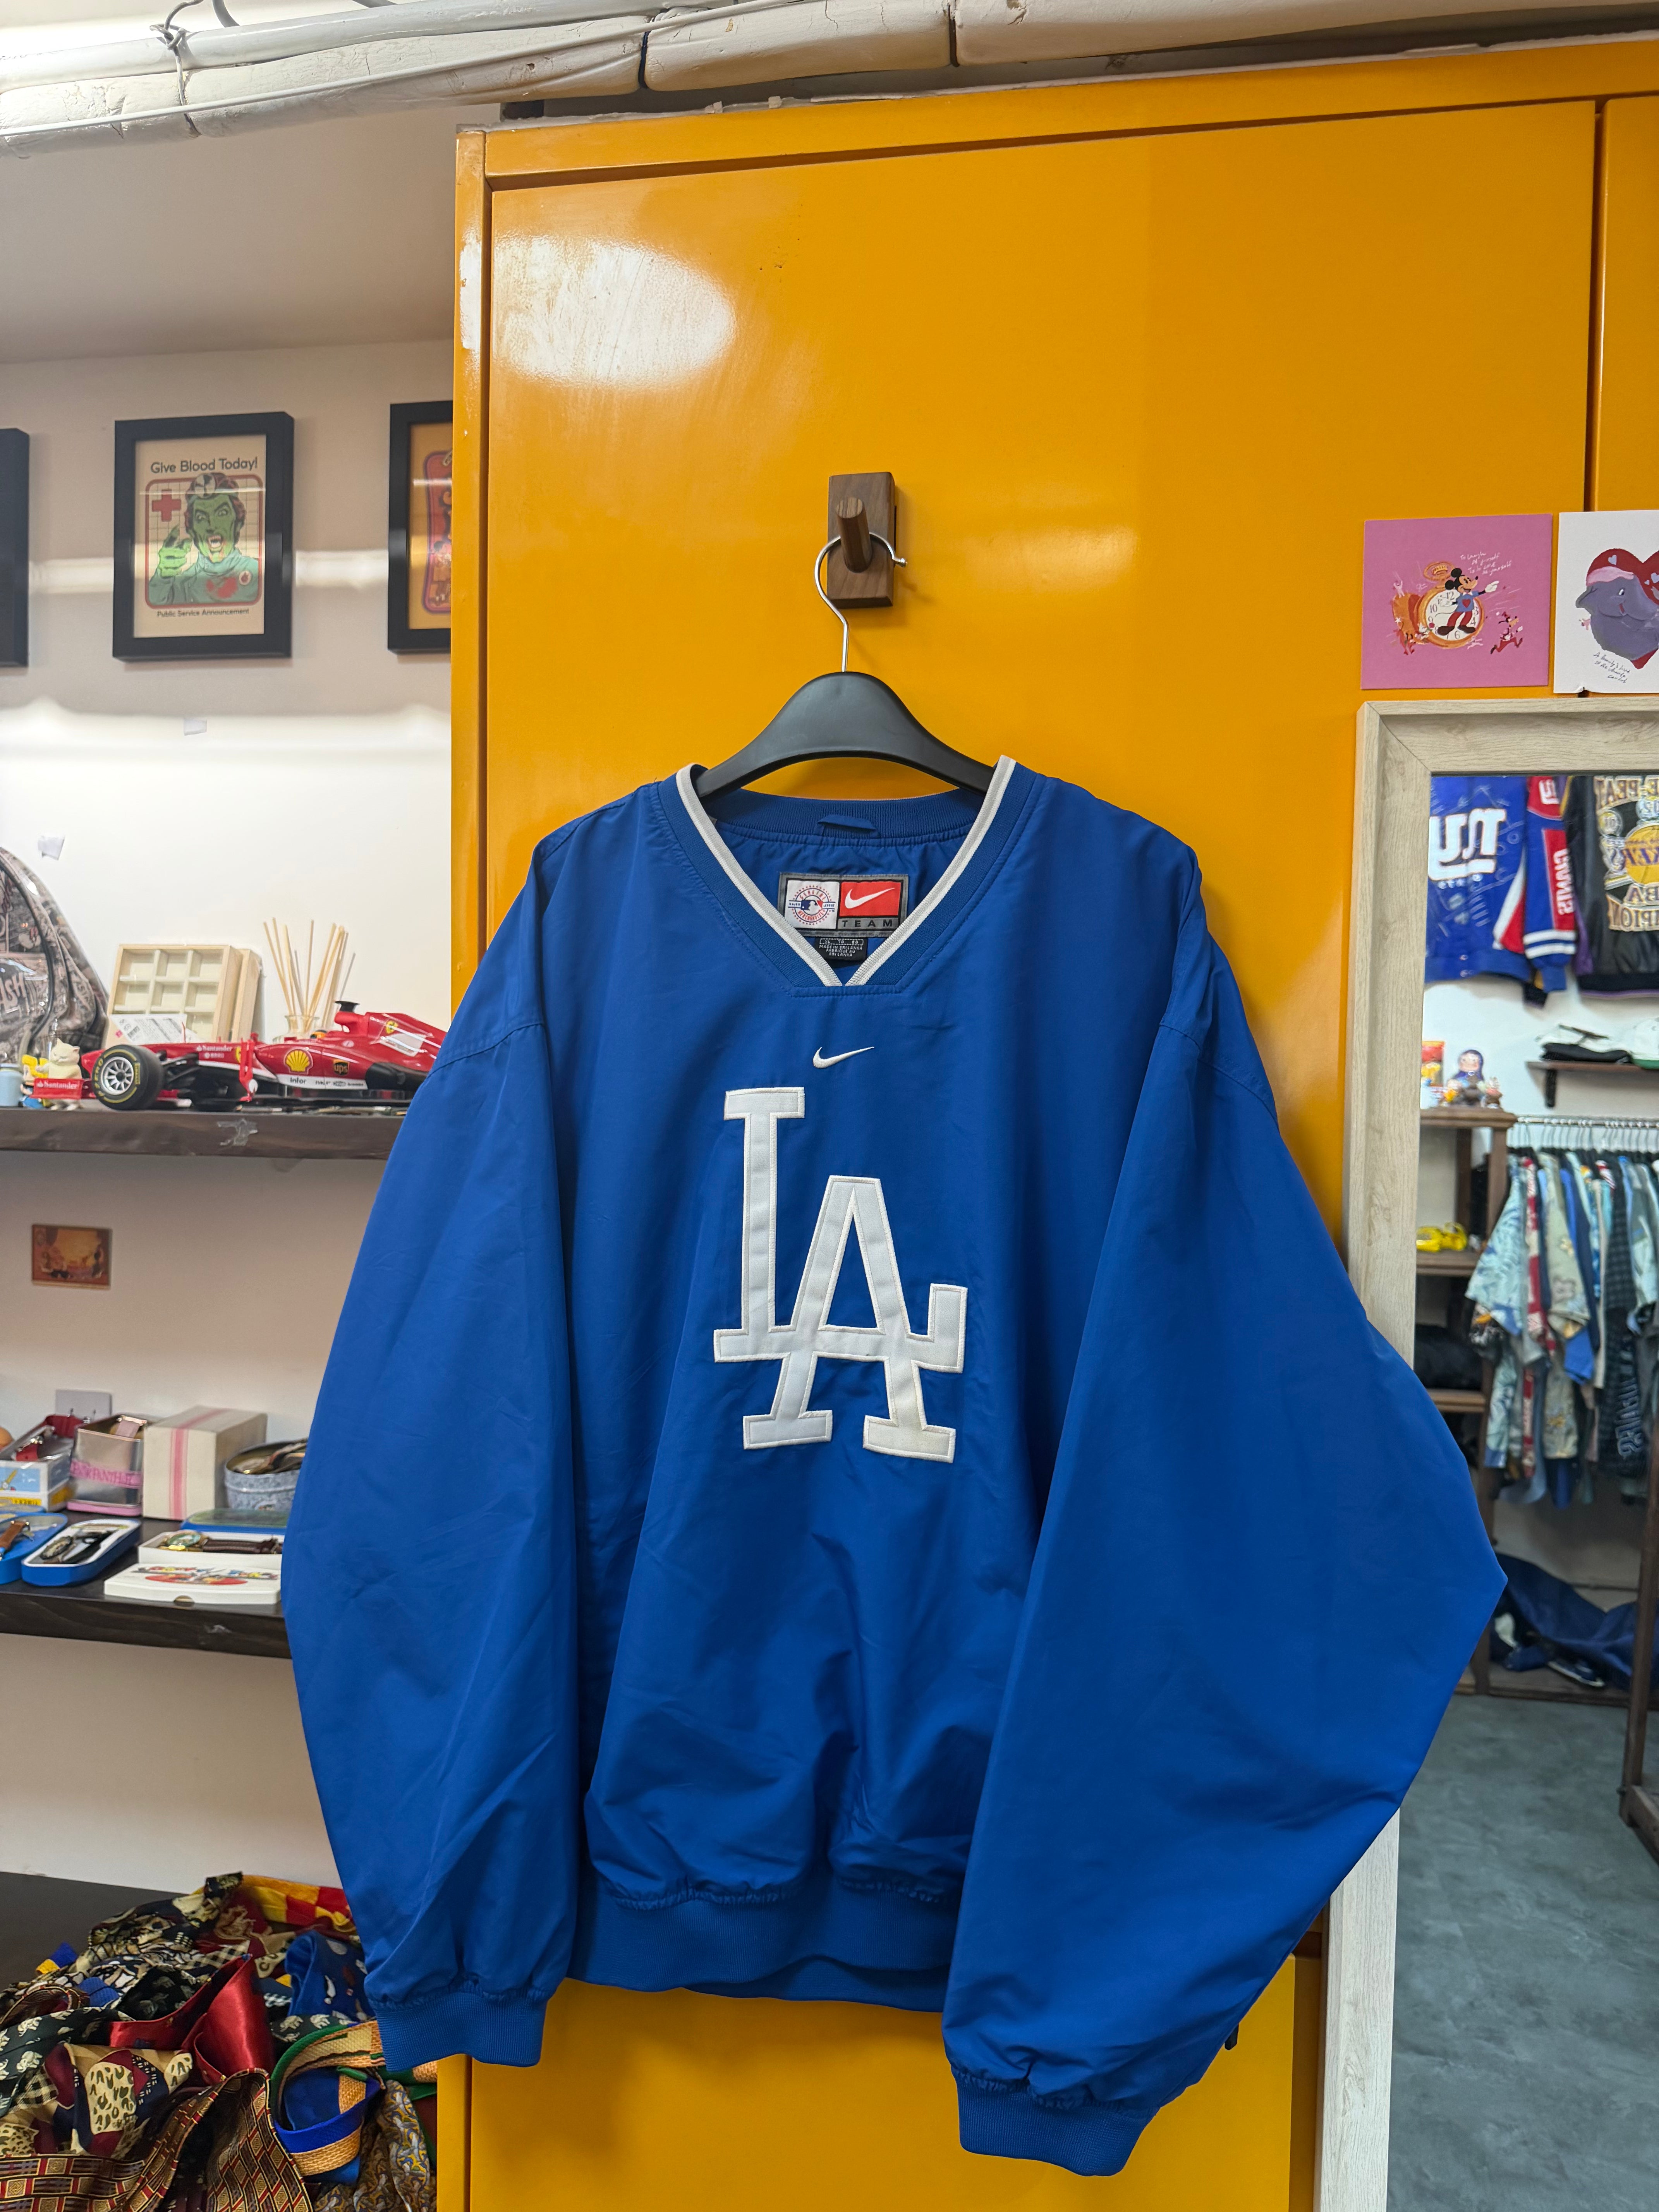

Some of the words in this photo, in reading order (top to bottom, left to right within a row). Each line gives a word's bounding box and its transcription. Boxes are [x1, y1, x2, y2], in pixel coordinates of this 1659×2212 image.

[151, 462, 176, 474] Give
[180, 459, 215, 472] Blood
[219, 456, 258, 471] Today!
[1446, 591, 1455, 601] 12
[1430, 604, 1437, 613] 10
[1455, 630, 1460, 639] 6
[842, 919, 892, 927] TEAM
[334, 1065, 348, 1074] ups
[43, 1080, 78, 1089] Santander
[713, 1087, 968, 1463] LA
